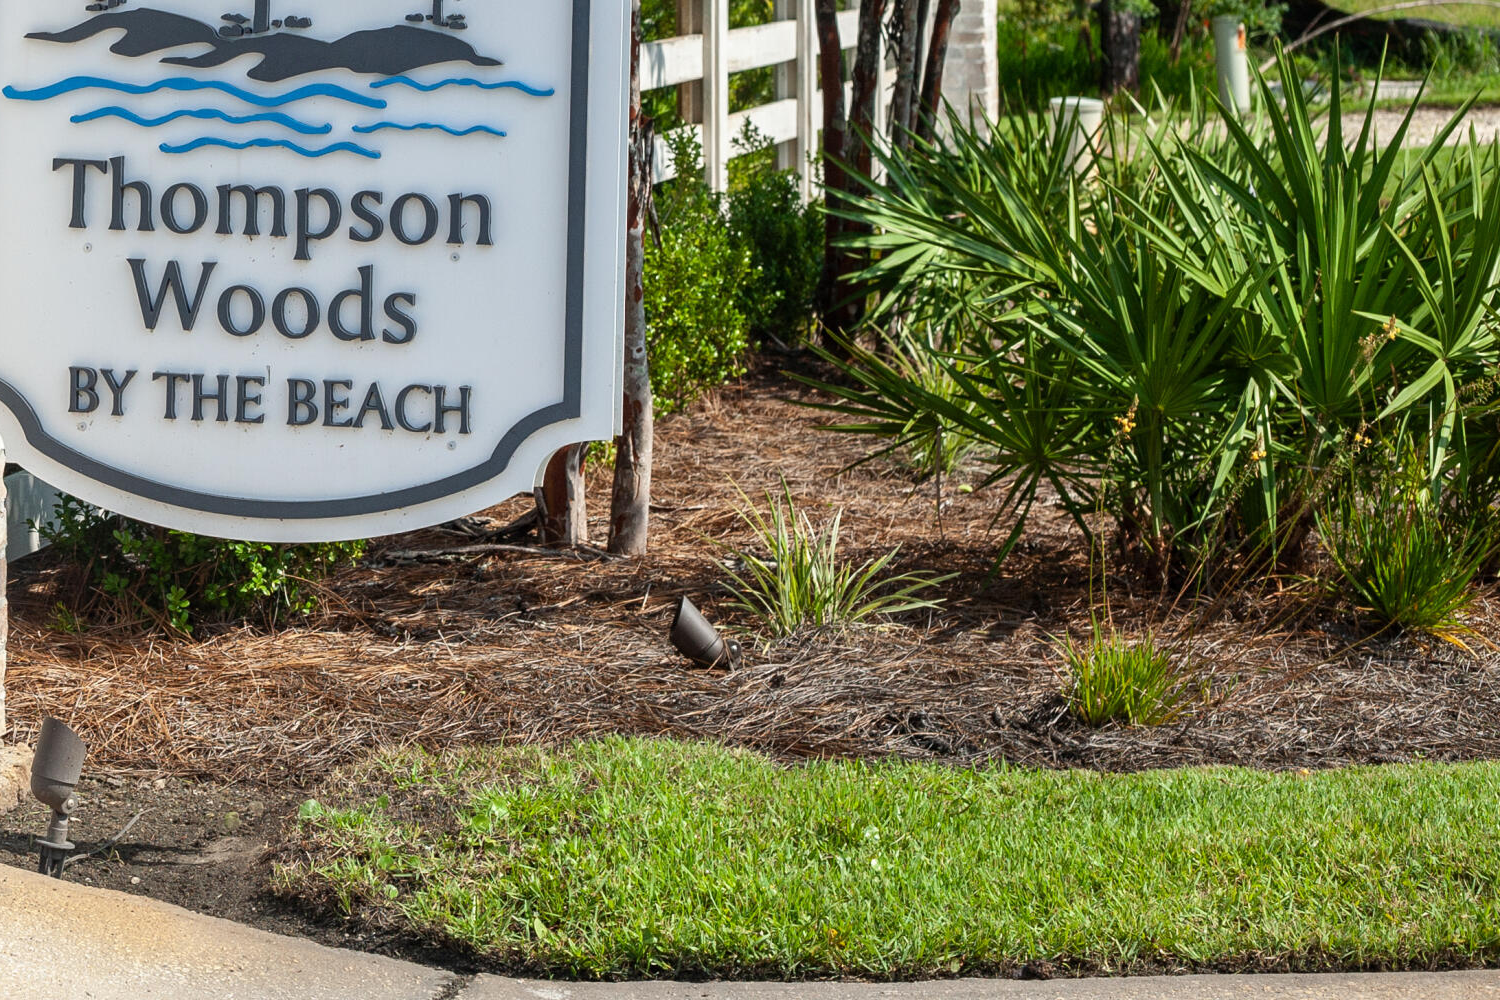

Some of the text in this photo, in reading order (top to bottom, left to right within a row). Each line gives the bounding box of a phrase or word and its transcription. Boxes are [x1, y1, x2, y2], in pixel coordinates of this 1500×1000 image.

[52, 155, 494, 261] Thompson
[126, 258, 418, 345] Woods
[67, 365, 473, 435] BY THE BEACH
